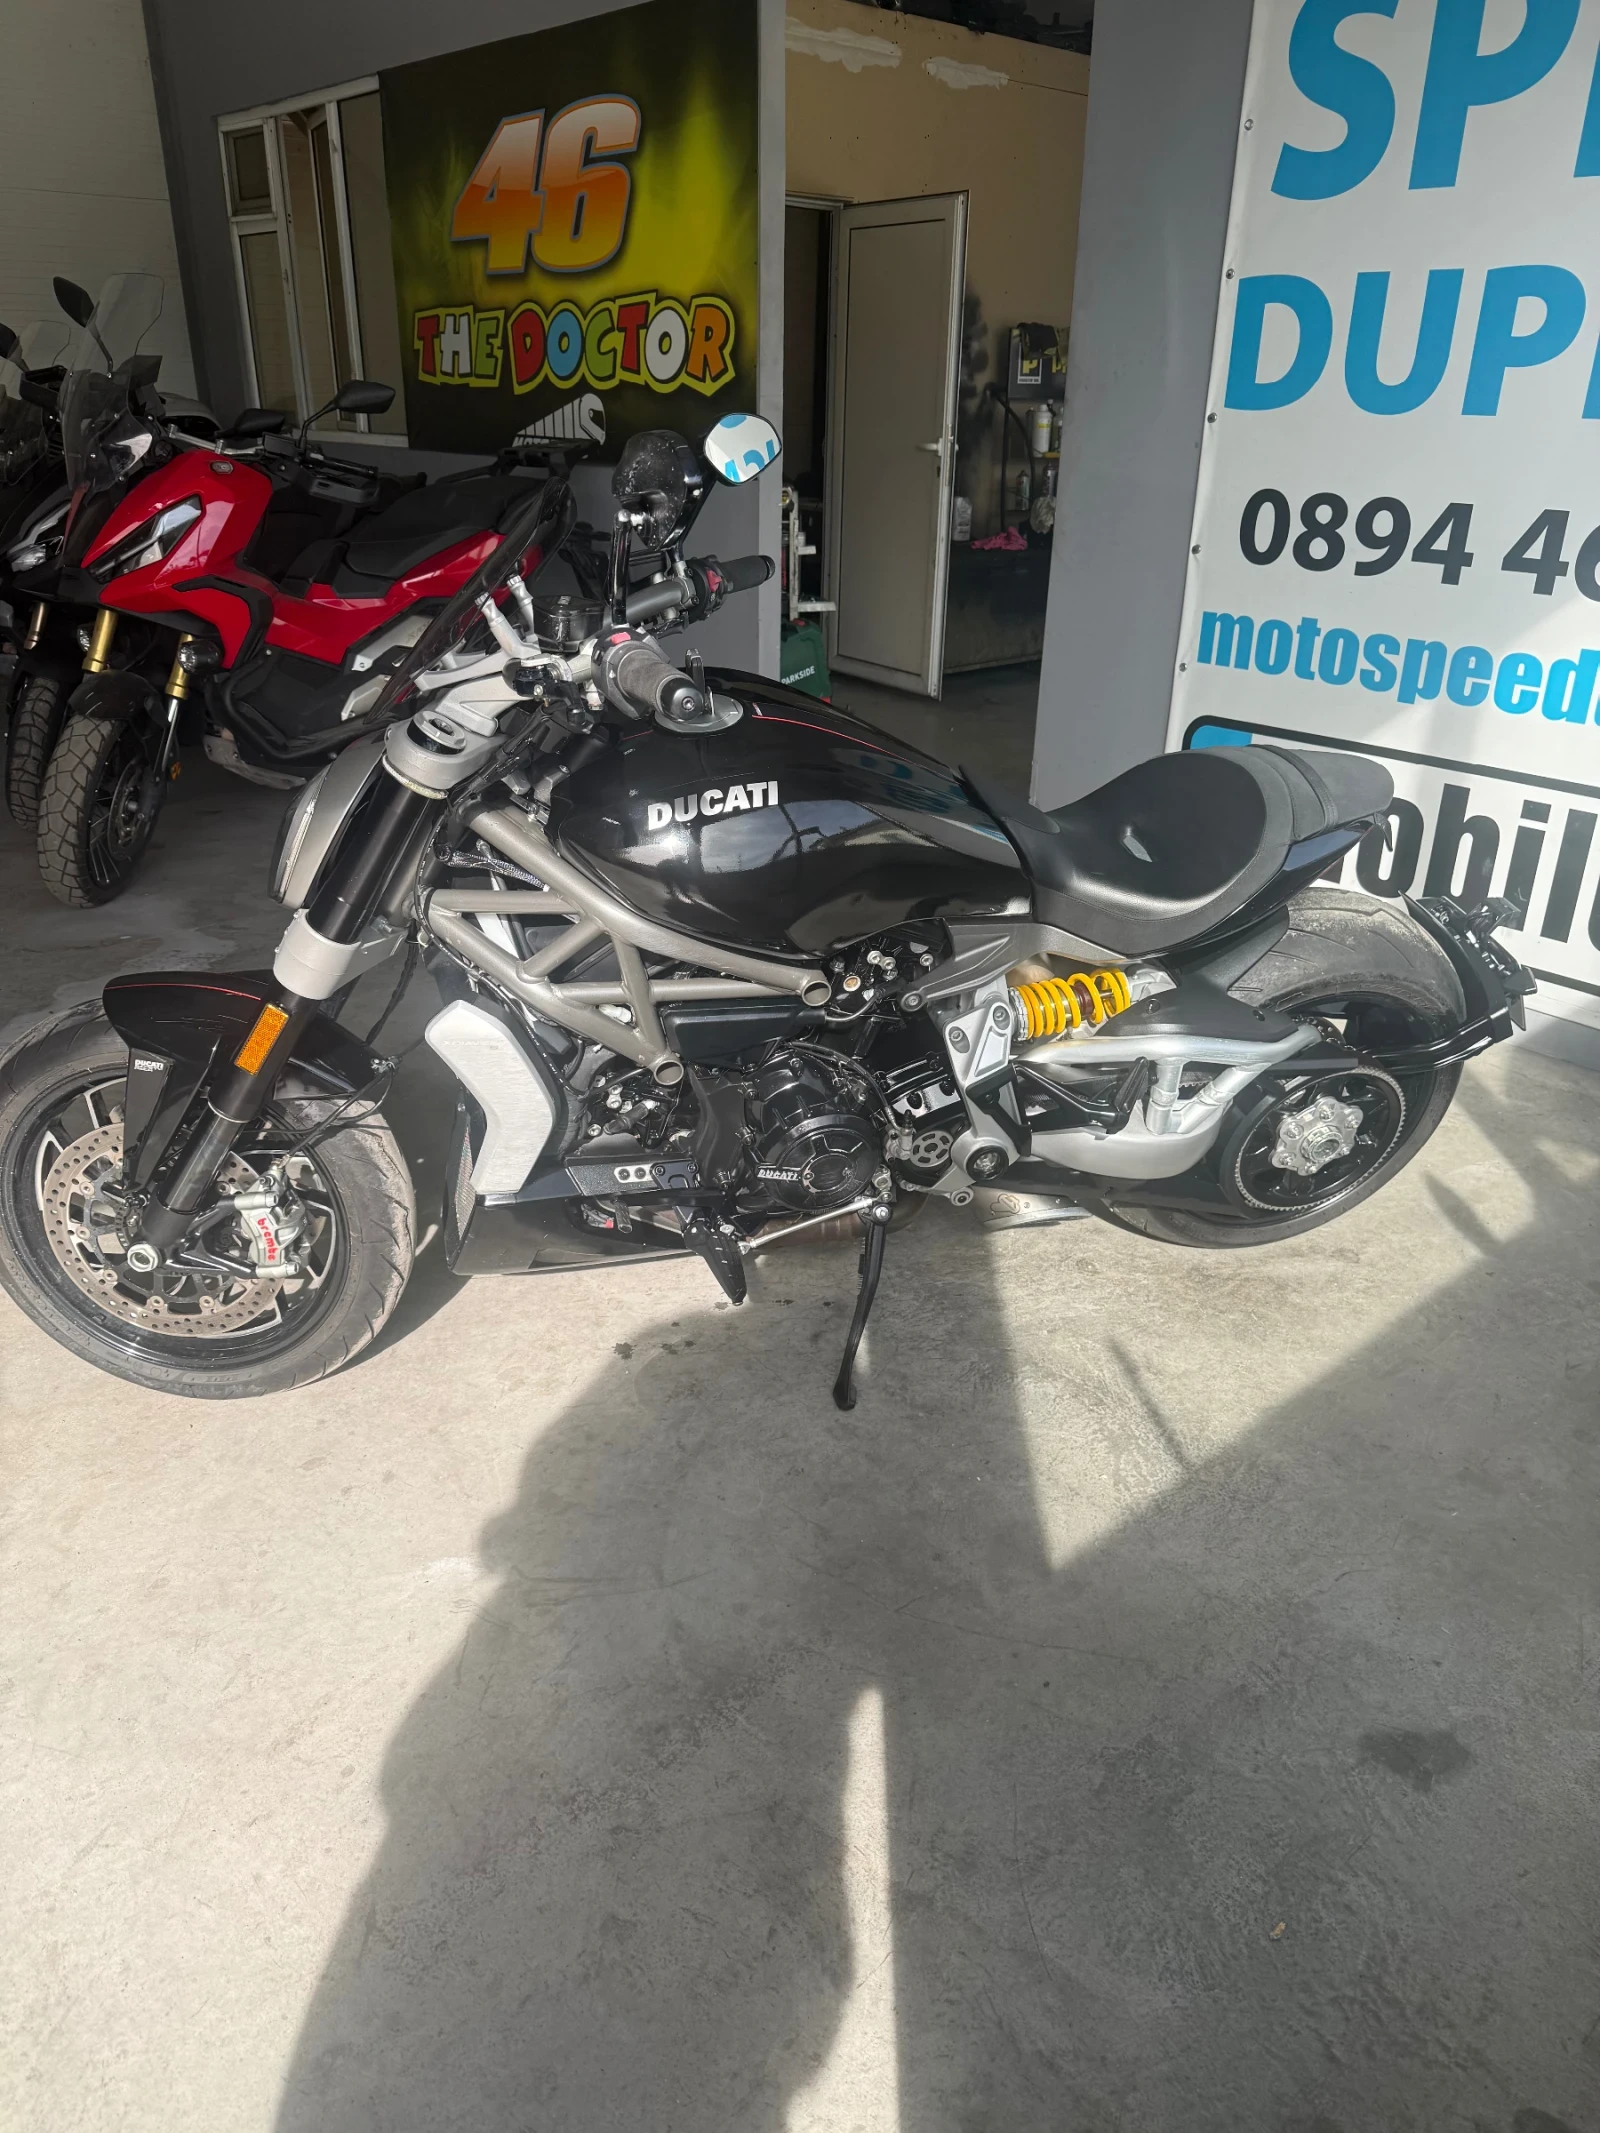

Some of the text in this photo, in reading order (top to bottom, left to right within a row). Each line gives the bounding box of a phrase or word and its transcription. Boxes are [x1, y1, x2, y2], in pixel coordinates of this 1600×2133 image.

[1271, 0, 1600, 201] SP
[451, 93, 641, 275] 46
[414, 291, 736, 396] THE DOCTOR
[1224, 264, 1600, 420] DUP
[1239, 488, 1474, 586] 0894
[781, 665, 815, 685] PARKSIDE
[1197, 610, 1600, 727] motospeed
[647, 780, 779, 831] DUCATI
[1318, 783, 1600, 952] obil
[757, 1169, 798, 1181] DUCATI
